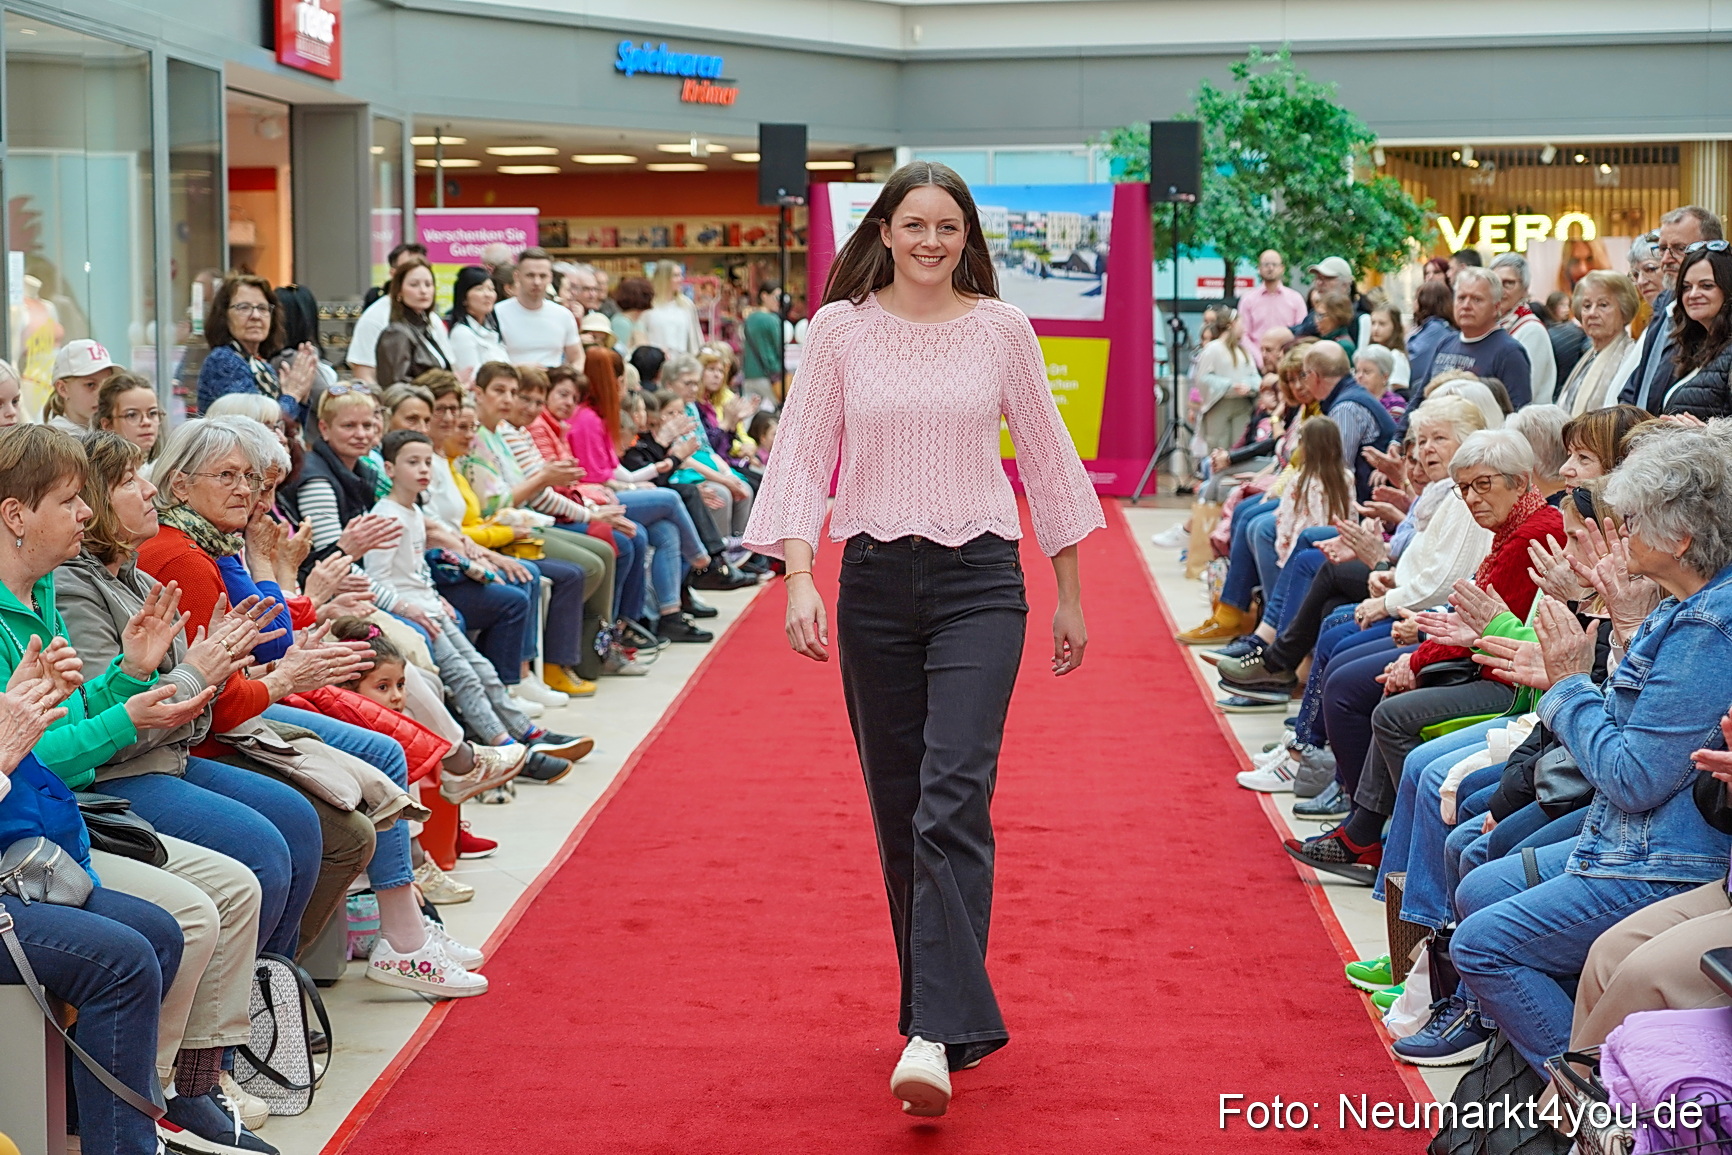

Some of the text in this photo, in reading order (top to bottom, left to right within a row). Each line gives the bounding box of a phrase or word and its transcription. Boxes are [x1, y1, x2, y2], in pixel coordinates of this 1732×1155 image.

[615, 40, 724, 77] Spielwaren
[423, 228, 527, 243] Verschenken Sie
[1437, 212, 1597, 253] VERO
[87, 342, 108, 360] LA
